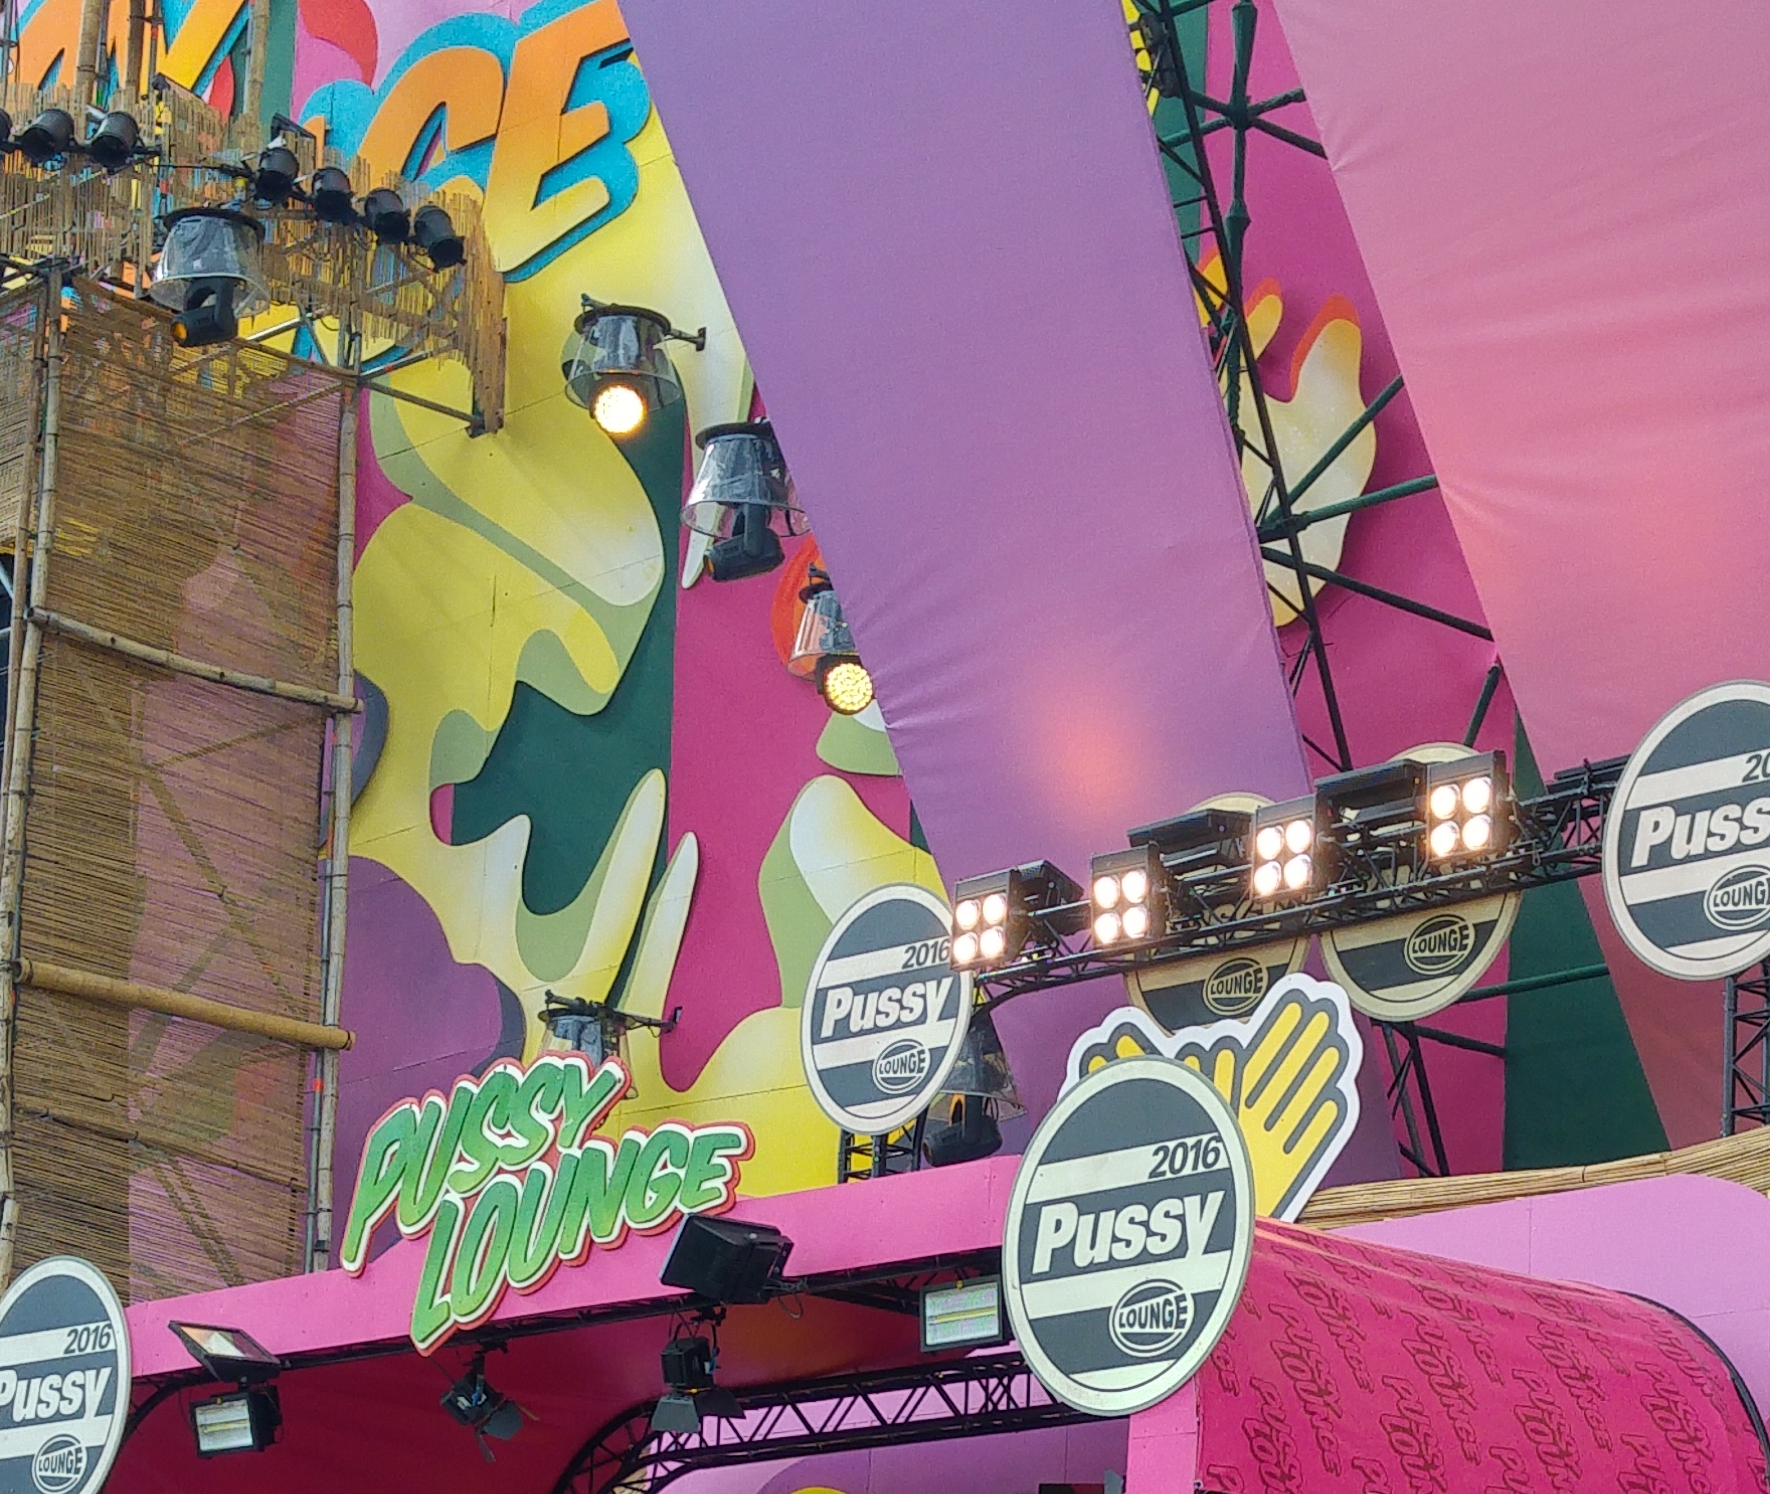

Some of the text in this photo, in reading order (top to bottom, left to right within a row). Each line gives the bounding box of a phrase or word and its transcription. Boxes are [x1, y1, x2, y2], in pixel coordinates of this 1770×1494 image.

[902, 938, 951, 970] 2016
[1410, 923, 1471, 955] LOUNGE
[820, 976, 955, 1039] Pussy
[1209, 966, 1263, 997] LOUNGE
[878, 1048, 926, 1076] LOUNGE
[342, 1058, 624, 1270] PUSSY
[1148, 1136, 1223, 1179] 2016
[411, 1125, 746, 1348] LOUNGE
[1032, 1190, 1226, 1275] Pussy
[63, 1324, 112, 1354] 2016
[1118, 1293, 1189, 1331] LOUNGE
[1268, 1303, 1343, 1419] PUSSY
[1270, 1340, 1343, 1477] LOUNGE
[1381, 1375, 1447, 1493] PUSSY
[1401, 1338, 1482, 1466] LOUNGE
[1512, 1368, 1582, 1480] PUSSY
[1635, 1361, 1713, 1462] PUSSY
[38, 1446, 83, 1476] LOUNGE
